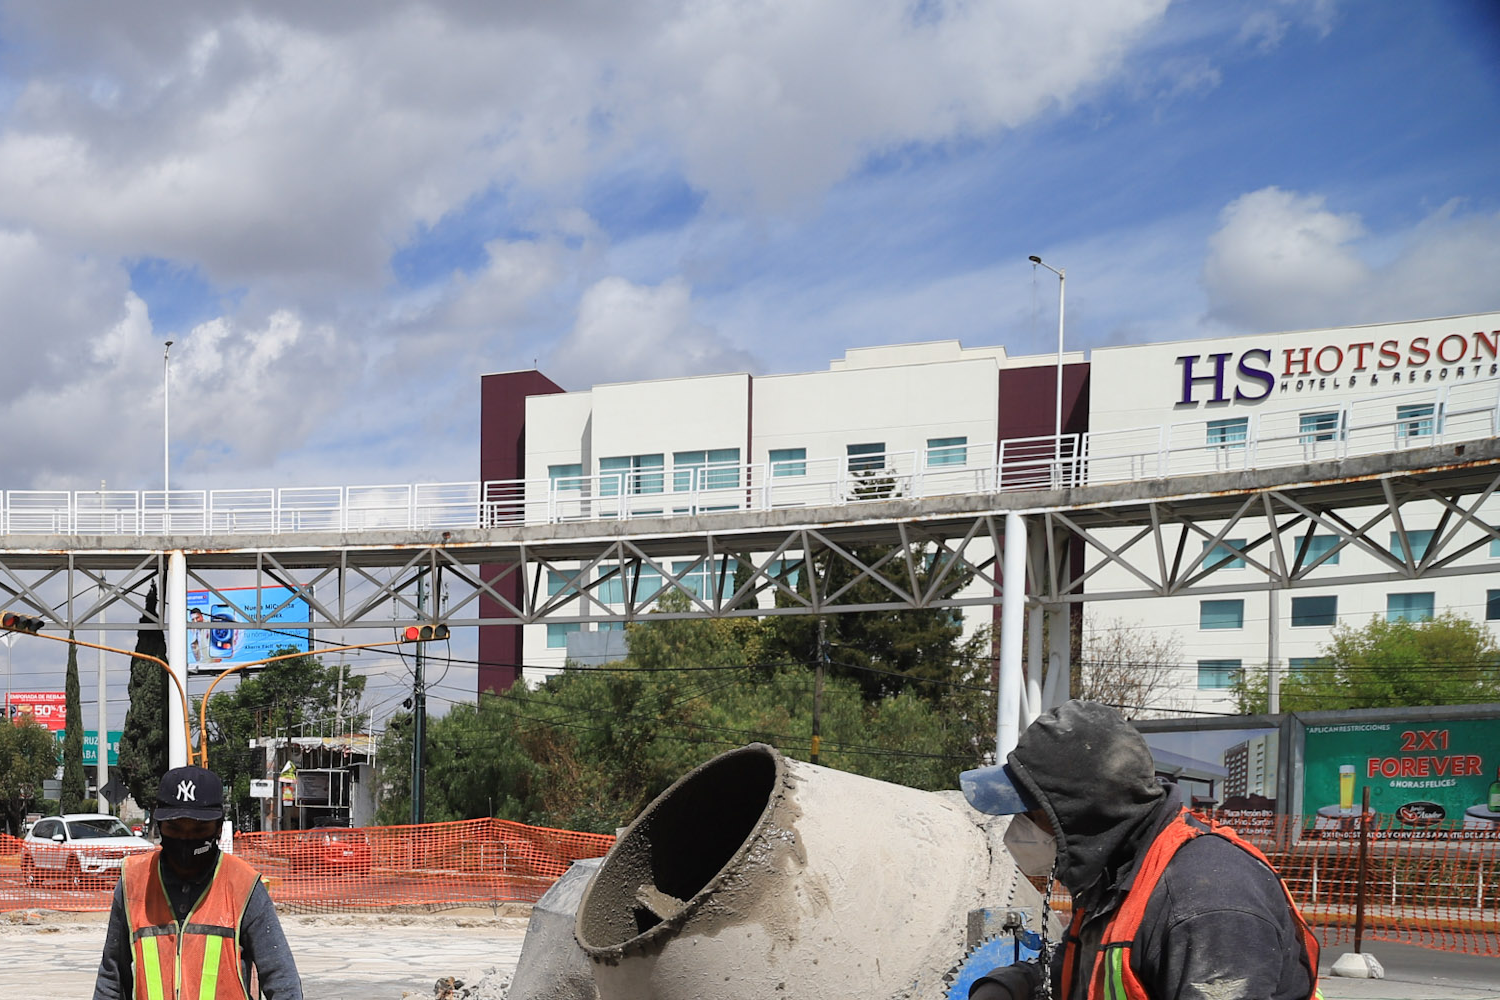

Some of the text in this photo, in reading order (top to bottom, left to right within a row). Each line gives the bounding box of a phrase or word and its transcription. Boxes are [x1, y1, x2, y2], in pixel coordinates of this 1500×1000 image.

[1281, 329, 1500, 377] HOTSSON
[1173, 347, 1276, 408] HS
[1280, 363, 1498, 393] HOTELS & RESORTS
[1399, 730, 1449, 752] 2X1
[1367, 754, 1483, 779] FOREVER
[1395, 780, 1424, 789] HORAS
[1425, 779, 1457, 788] FELICES
